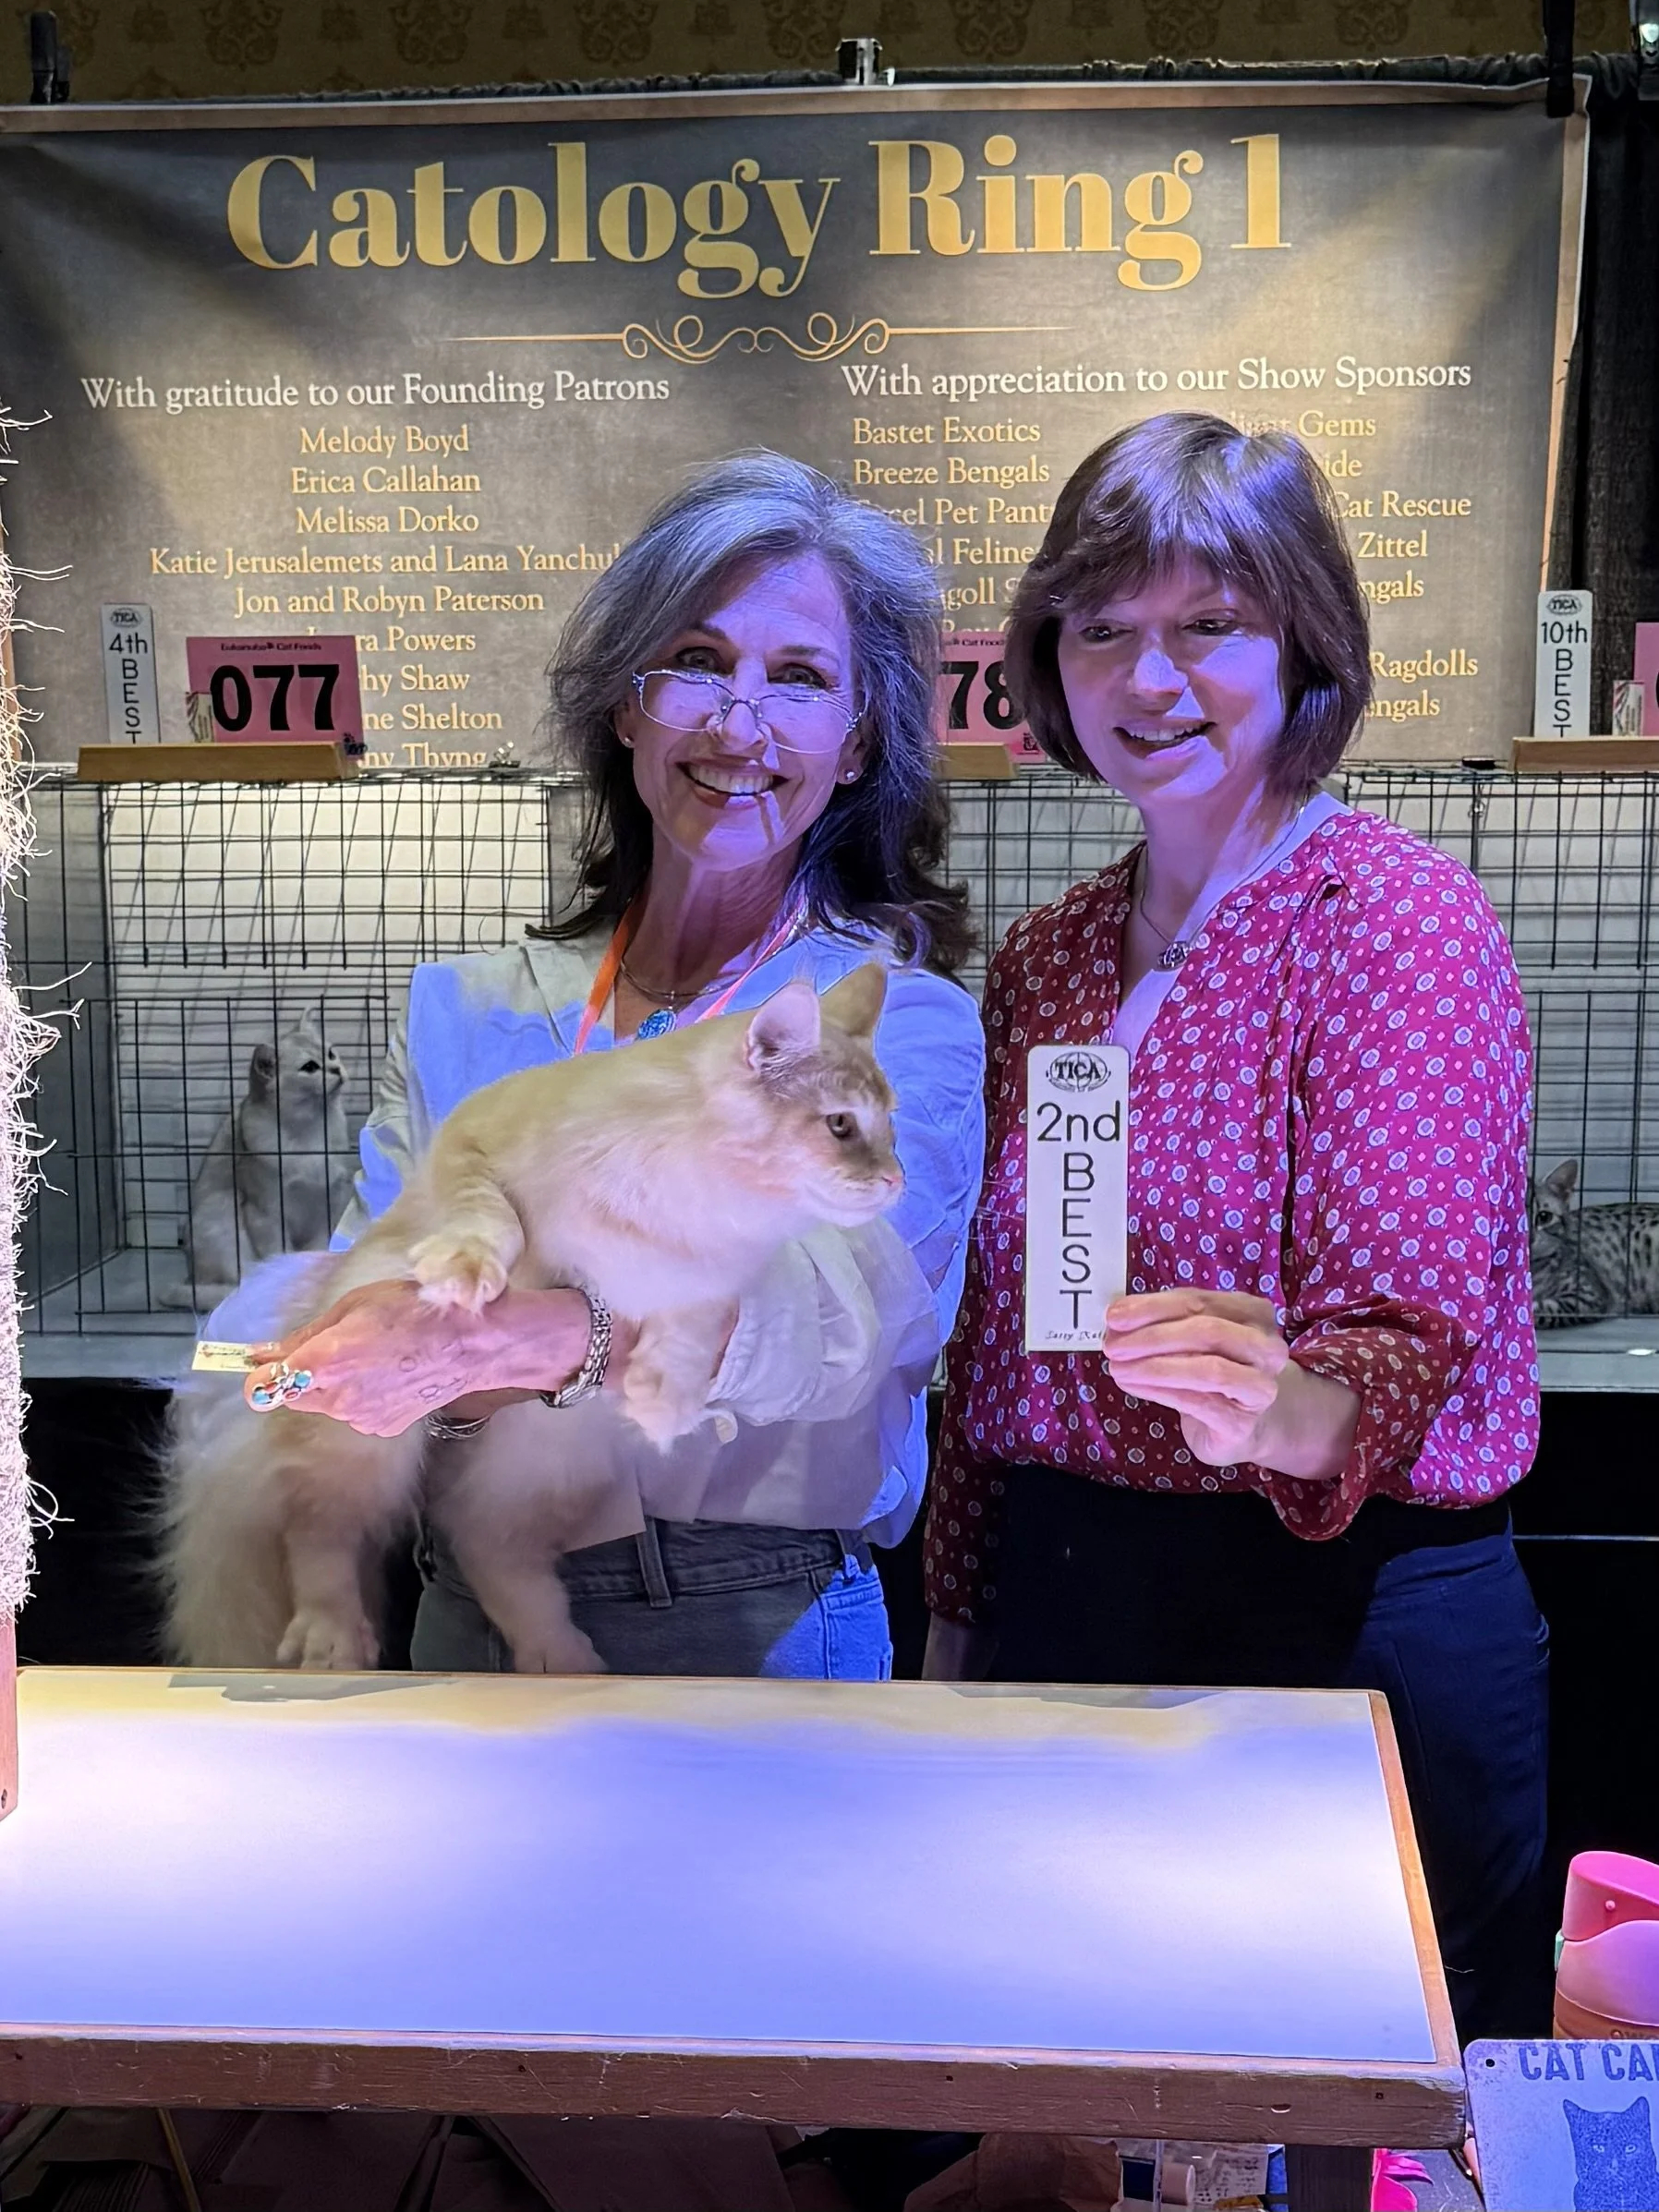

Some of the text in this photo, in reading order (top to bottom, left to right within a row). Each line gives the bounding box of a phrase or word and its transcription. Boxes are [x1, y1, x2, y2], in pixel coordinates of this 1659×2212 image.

[227, 134, 1291, 299] Catology Ring 1
[81, 370, 671, 416] With gratitude to our Founding Patrons
[842, 356, 1471, 403] With appreciation to our Show Sponsors
[854, 416, 1041, 444] Bastet Exotics
[1298, 410, 1376, 438] Gems
[300, 424, 469, 458] Melody Boyd
[292, 465, 481, 493] Erica Callahan
[854, 454, 1049, 490] Breeze Bengals
[297, 504, 479, 535] Melissa Dorko
[935, 499, 979, 526] Pet
[987, 498, 1055, 525] Pant
[1335, 490, 1471, 518] Cat Rescue
[953, 538, 1040, 565] Feline
[1358, 529, 1429, 558] Zittel
[150, 548, 217, 574] Katie
[224, 546, 383, 580] Jerusalemets
[390, 545, 437, 573] and
[444, 545, 509, 573] Lana
[235, 585, 544, 619] Jon and Robyn Paterson
[108, 633, 148, 655] 4th
[386, 625, 476, 652] Powers
[1541, 621, 1587, 644] 10th
[400, 663, 470, 691] Shaw
[1369, 648, 1479, 683] Ragdolls
[122, 659, 141, 744] BEST
[210, 664, 340, 731] 077
[1553, 648, 1573, 738] BEST
[401, 702, 503, 731] Shelton
[1055, 1062, 1101, 1080] TICA
[1036, 1100, 1120, 1142] 2nd
[1060, 1153, 1096, 1330] BEST
[1519, 2043, 1659, 2082] CAT CA
